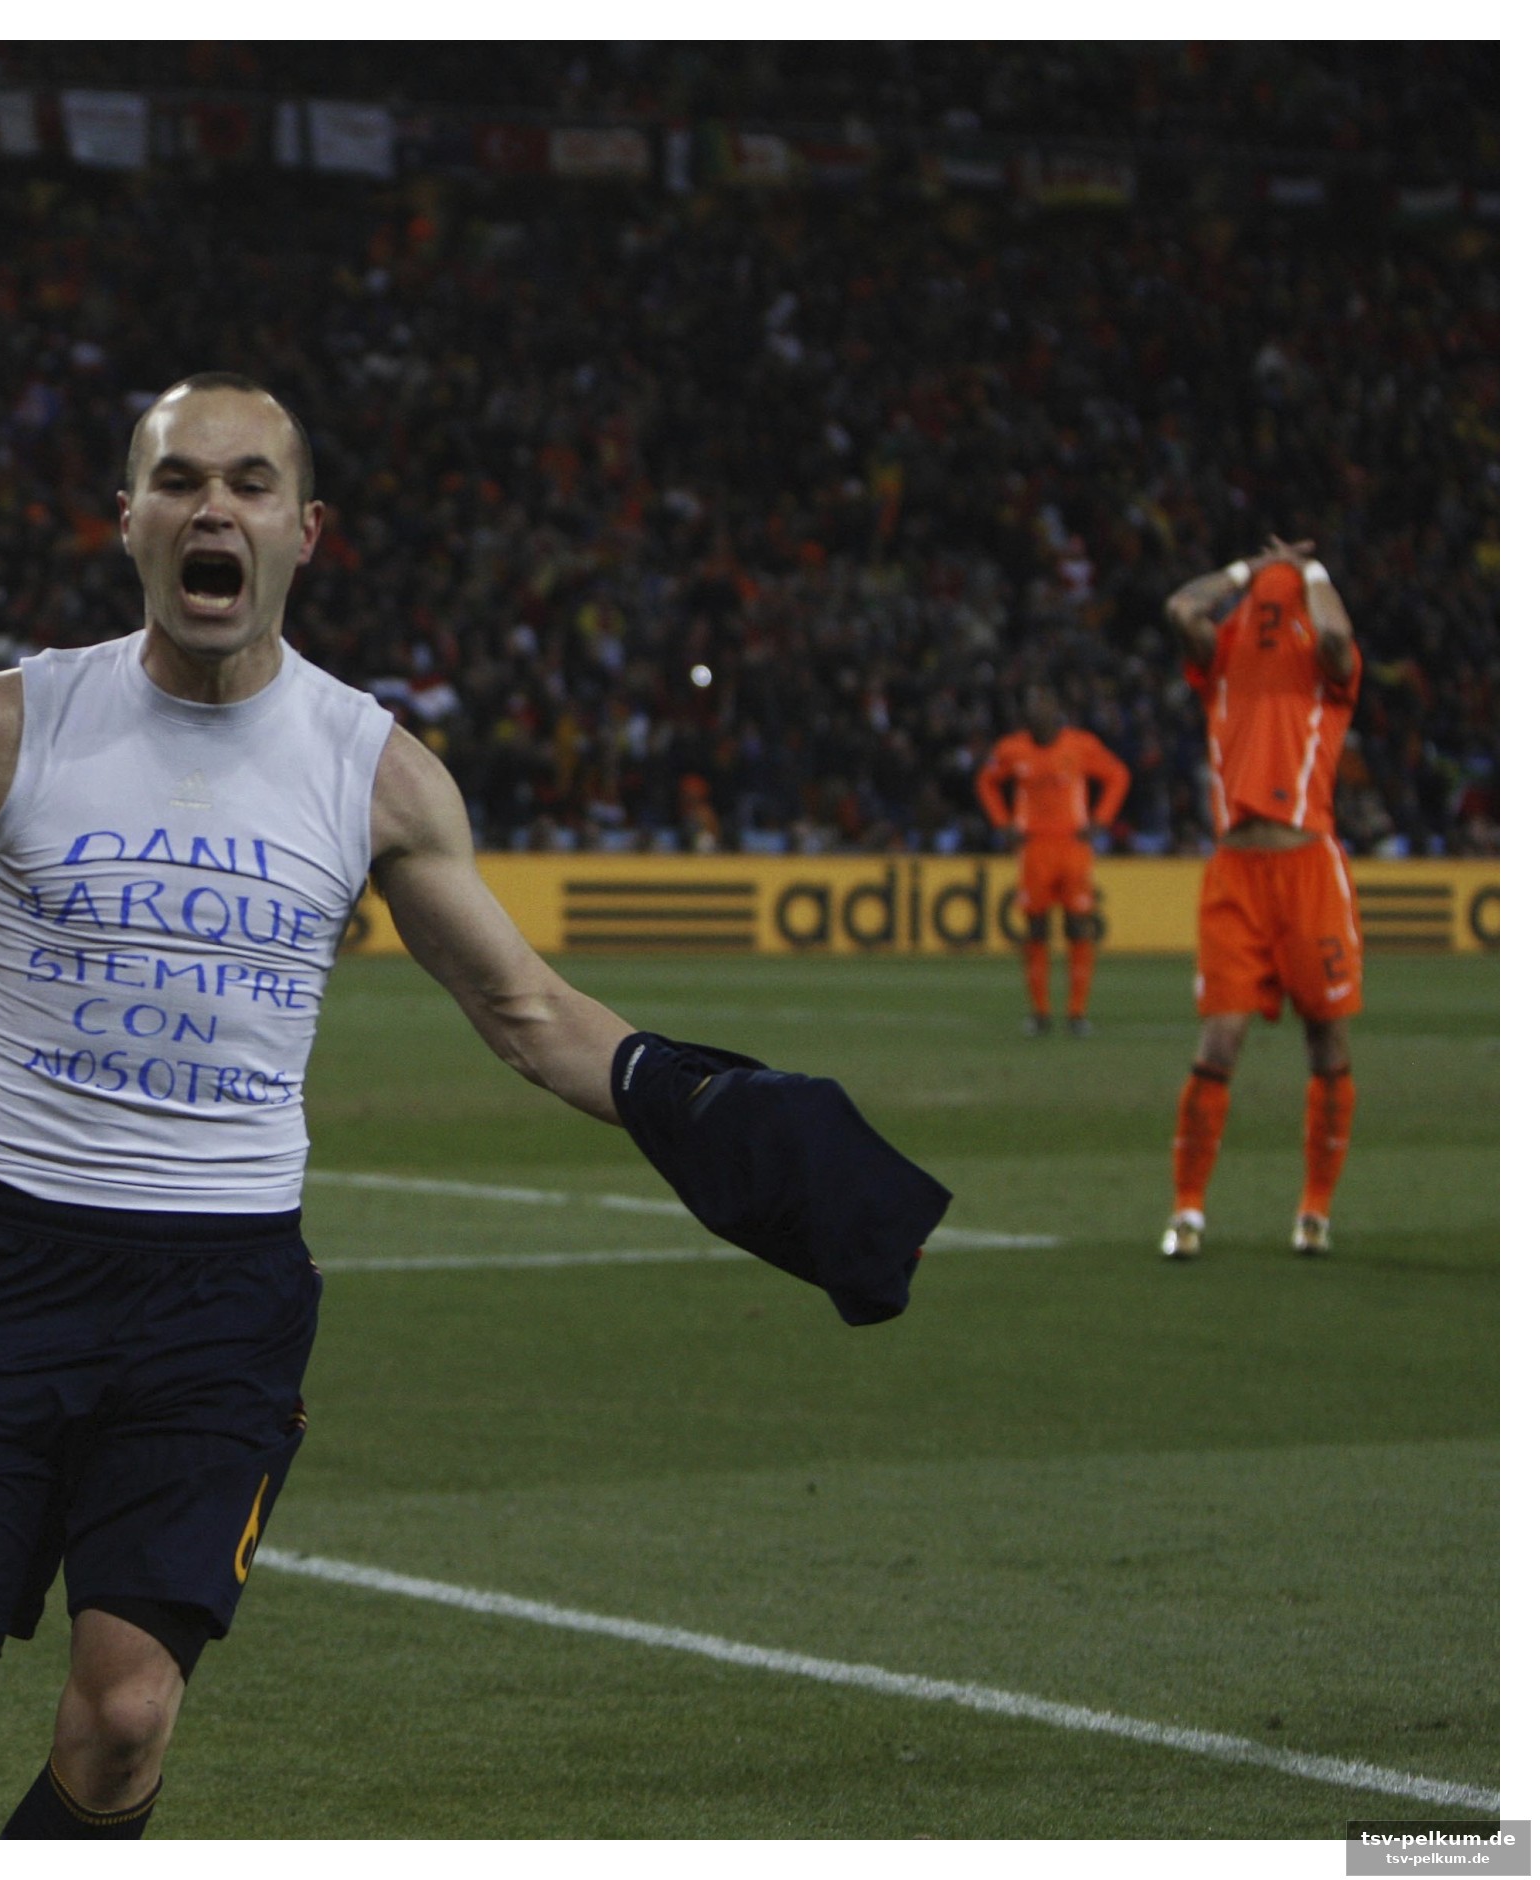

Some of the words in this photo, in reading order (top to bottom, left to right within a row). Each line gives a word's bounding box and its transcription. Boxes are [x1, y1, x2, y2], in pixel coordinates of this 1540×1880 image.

[62, 828, 269, 881] DANI
[775, 859, 1108, 947] adid
[27, 948, 311, 1009] SIEMPRE
[72, 997, 218, 1045] CON
[24, 1048, 292, 1104] NOSOTROS
[234, 1473, 270, 1585] 6
